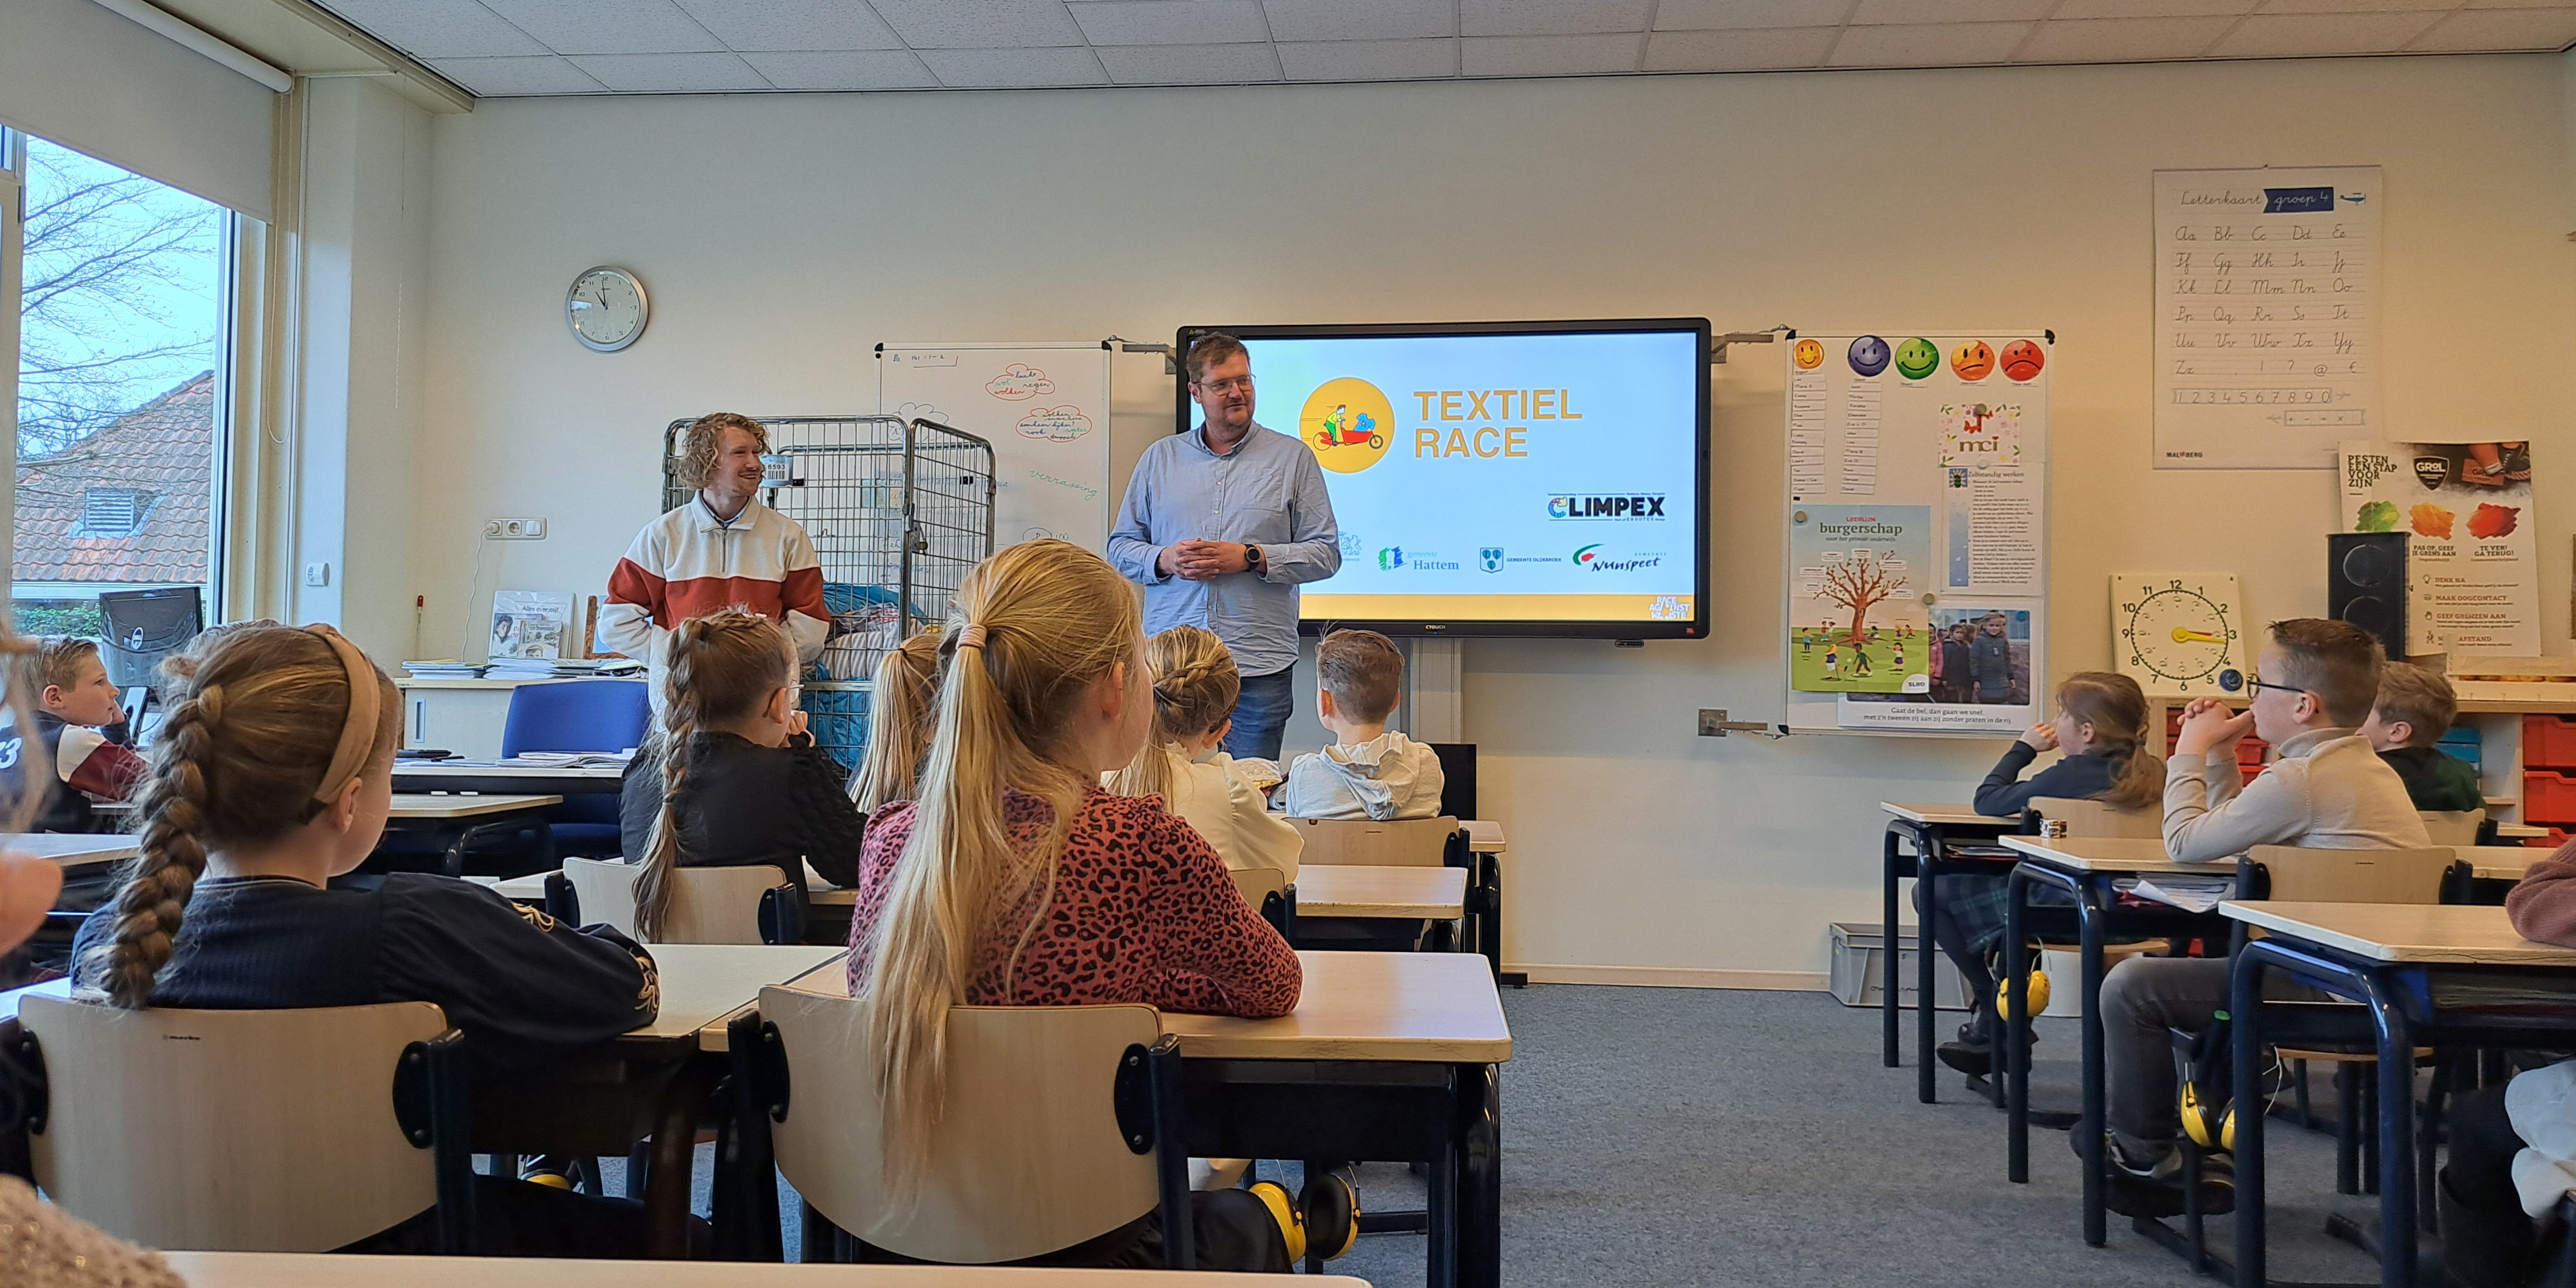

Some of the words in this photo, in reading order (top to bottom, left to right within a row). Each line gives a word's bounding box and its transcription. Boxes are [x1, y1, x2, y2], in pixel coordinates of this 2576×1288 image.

[2180, 191, 2262, 206] Letterkaart
[2273, 194, 2316, 211] groep
[2320, 191, 2329, 201] 4
[2175, 226, 2196, 241] Aa
[2214, 226, 2233, 241] Bb
[2252, 226, 2266, 241] Cc
[2292, 226, 2311, 240] Dd
[2332, 224, 2346, 239] Ee
[2175, 280, 2196, 294] Kk
[2214, 279, 2231, 294] Ll
[2252, 280, 2285, 294] Mm
[2292, 279, 2316, 294] Nn
[2333, 277, 2353, 292] Oo
[2175, 306, 2194, 324] Pp
[2214, 306, 2235, 325] Qq
[2252, 306, 2273, 320] Rr
[2292, 306, 2305, 320] Ss
[2333, 305, 2349, 319] Tt
[2175, 333, 2194, 348] Uu
[2215, 333, 2236, 348] Vv
[2251, 333, 2281, 348] Ww
[2292, 333, 2314, 348] Xx
[2333, 332, 2354, 354] Yy
[2175, 360, 2194, 374] Zz
[2314, 364, 2328, 377] @
[1015, 370, 1036, 379] lucht
[2178, 392, 2182, 404] 1
[2192, 392, 2199, 404] 2
[2208, 392, 2215, 404] 3
[2223, 392, 2231, 404] 4
[2238, 392, 2247, 404] 5
[2256, 391, 2263, 404] 6
[2272, 391, 2279, 404] 7
[2288, 391, 2296, 404] 8
[2305, 391, 2312, 404] 9
[2321, 391, 2330, 404] 0
[1413, 388, 1582, 422] TEXTIEL
[1414, 426, 1529, 459] RACE
[2348, 455, 2388, 464] PESTEN
[2373, 464, 2397, 472] STAP
[2348, 471, 2380, 480] VOOR
[1030, 470, 1097, 501] verrassing
[2348, 479, 2373, 489] ZIJN
[1548, 496, 1665, 518] CLIMPEX
[1819, 522, 1902, 536] burgerschap
[1413, 560, 1460, 570] Hattem
[1591, 557, 1661, 572] Nunspeet
[2169, 580, 2182, 589] 12
[2143, 586, 2152, 595] 11
[2198, 586, 2203, 595] 1
[2122, 603, 2135, 612] 10
[2220, 604, 2227, 613] 2
[2122, 629, 2129, 638] 9
[2229, 630, 2237, 640] 3
[2131, 656, 2139, 666] 8
[2223, 657, 2231, 666] 4
[2151, 674, 2158, 684] 7
[2207, 675, 2214, 684] 5
[2180, 681, 2187, 691] 6
[0, 738, 22, 769] 3
